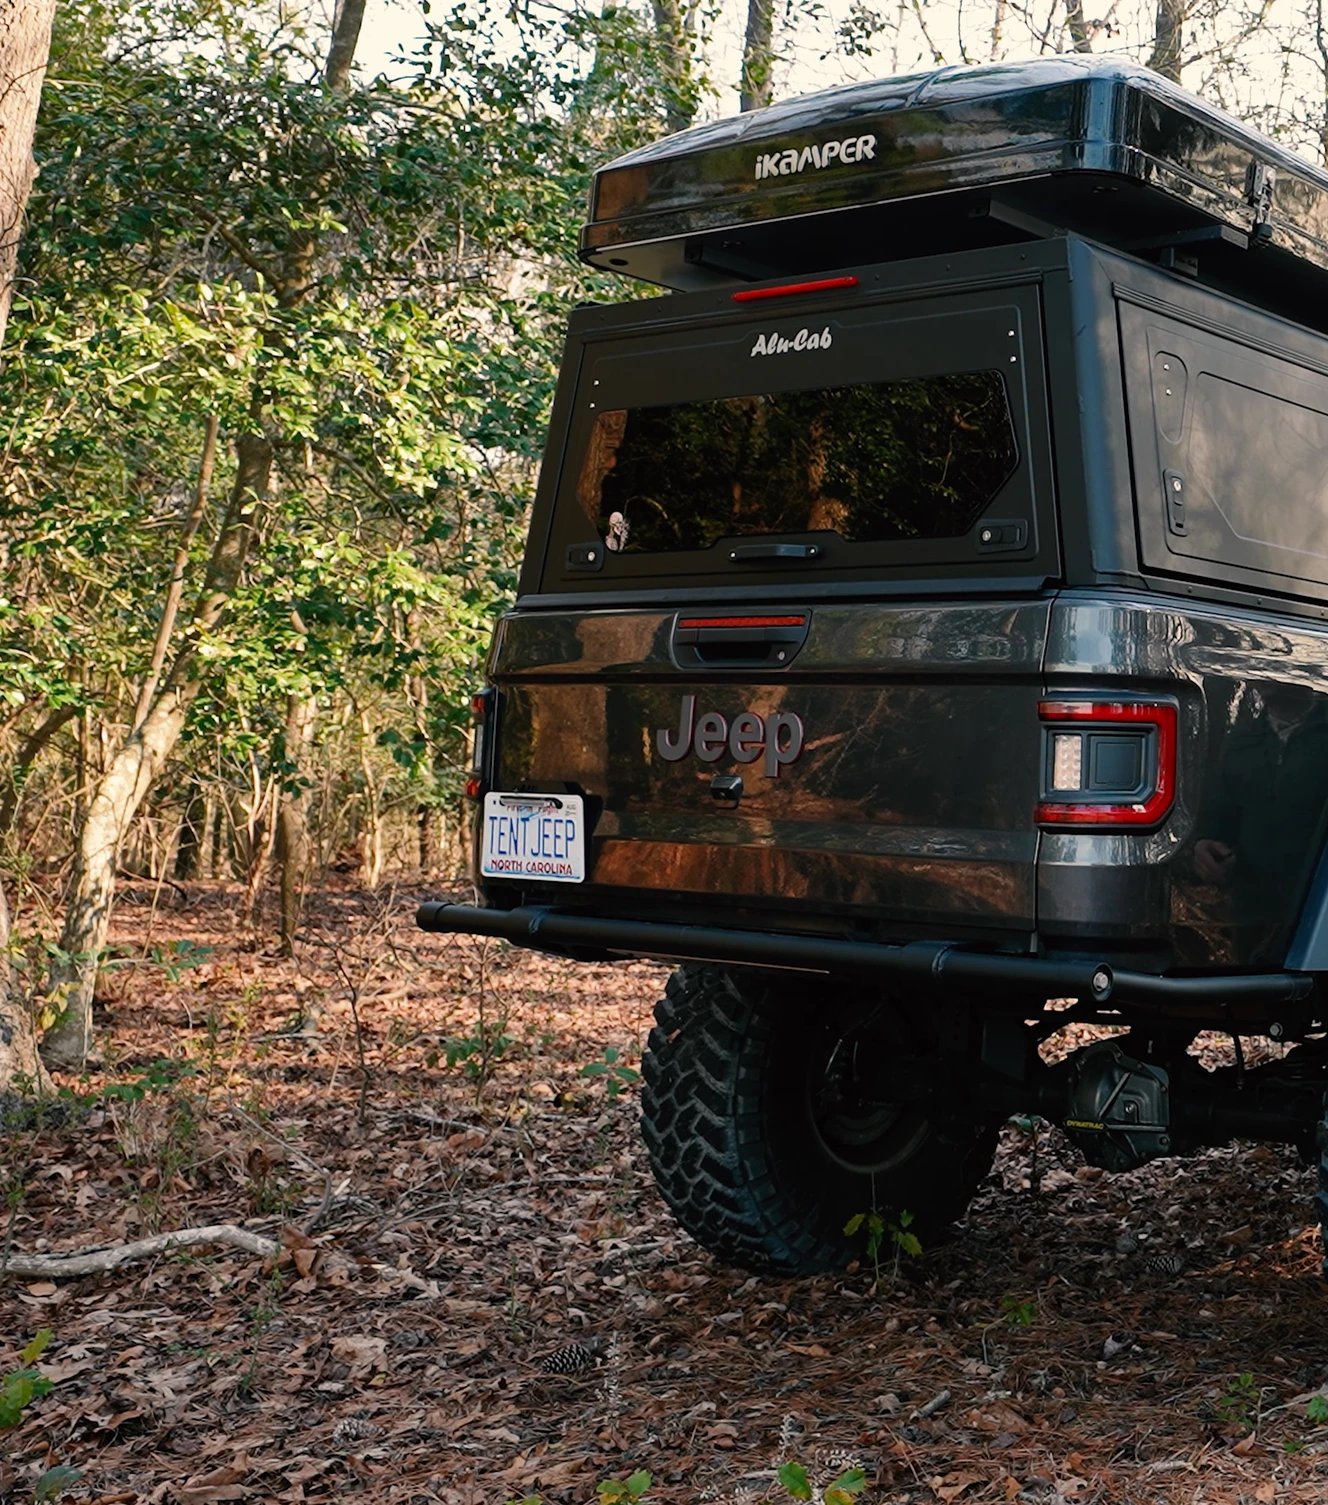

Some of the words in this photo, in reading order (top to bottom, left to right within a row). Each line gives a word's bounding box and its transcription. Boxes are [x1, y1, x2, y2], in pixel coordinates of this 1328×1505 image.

[750, 326, 833, 357] Alu-Cab
[656, 694, 804, 778] Jeep
[489, 816, 575, 859] TENTJEEP
[491, 859, 523, 872] NORTH
[526, 861, 573, 875] CAROLINA
